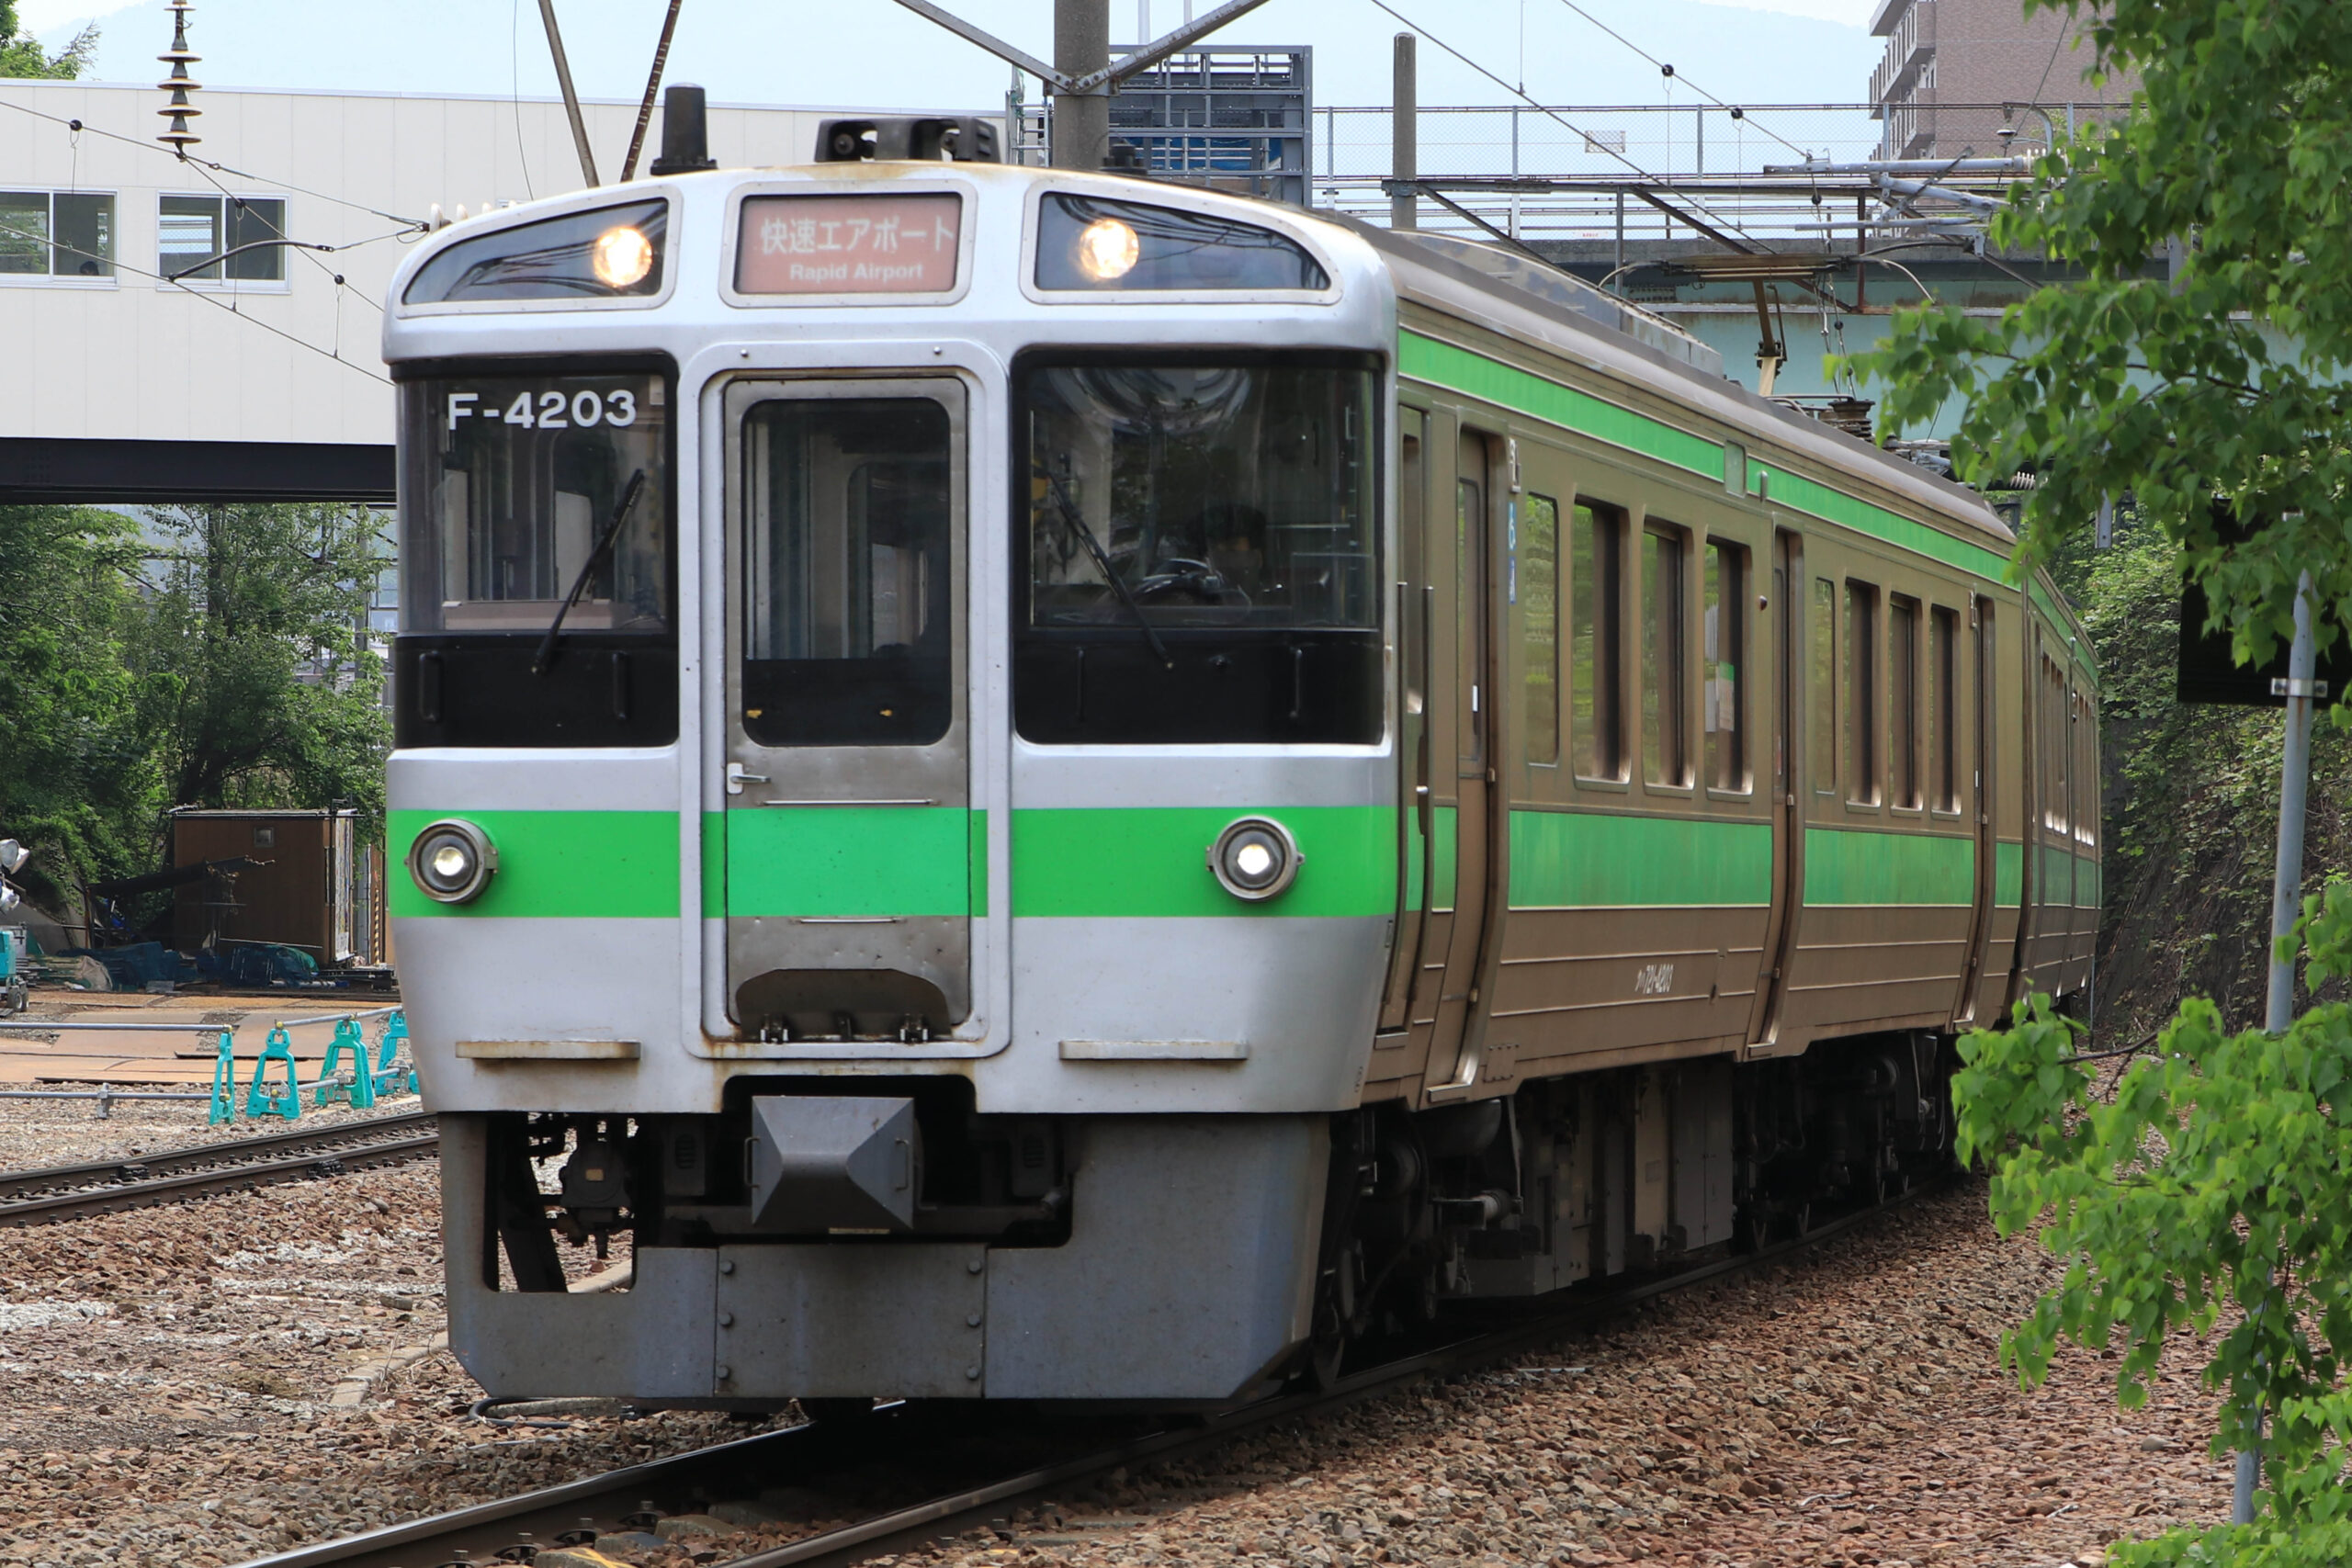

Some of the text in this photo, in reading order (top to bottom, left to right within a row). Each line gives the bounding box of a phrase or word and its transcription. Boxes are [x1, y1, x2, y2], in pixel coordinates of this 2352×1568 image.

[760, 215, 955, 255] 快速エアポート
[790, 263, 922, 285] Rapid Airport
[448, 389, 636, 430] F-4203
